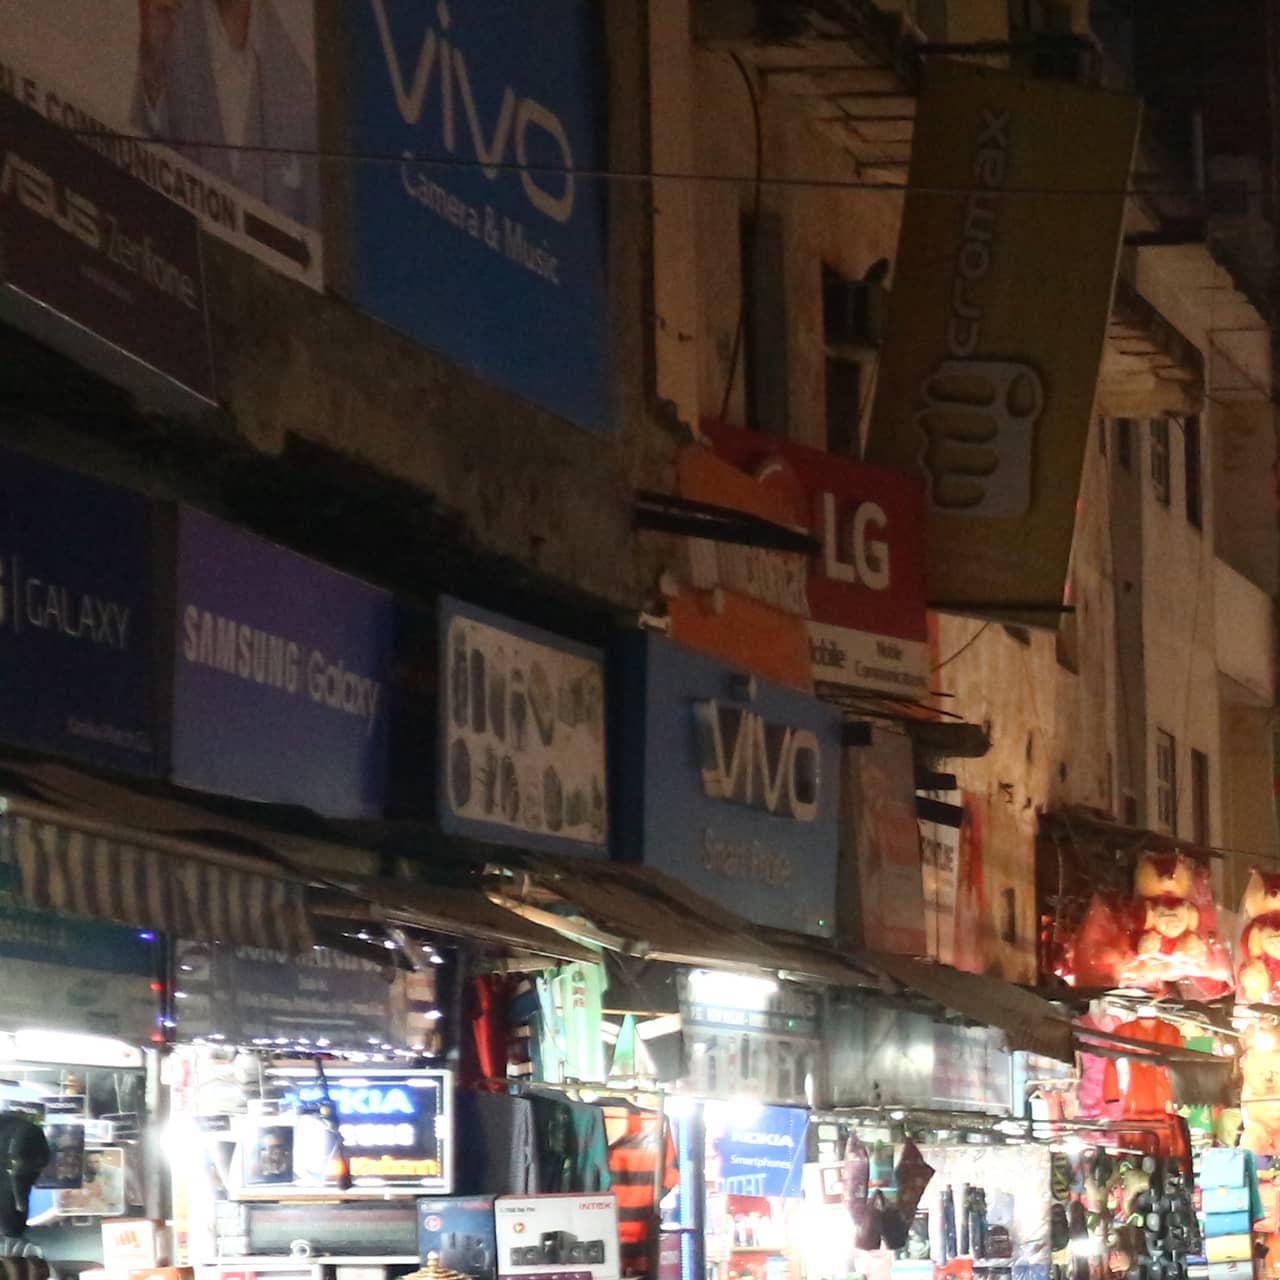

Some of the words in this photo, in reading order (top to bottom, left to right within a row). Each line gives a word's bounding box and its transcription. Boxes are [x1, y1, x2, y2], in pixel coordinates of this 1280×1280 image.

[372, 0, 575, 223] vivo
[401, 150, 482, 240] Camera
[483, 203, 501, 250] &
[503, 214, 561, 288] Music
[823, 491, 891, 591] LG
[25, 577, 132, 649] GALAXY
[184, 604, 299, 695] SAMSUNG
[306, 650, 382, 738] Galaxy
[703, 677, 821, 823] vivo
[730, 1153, 795, 1169] Smartphones
[731, 1131, 795, 1148] NOKIA
